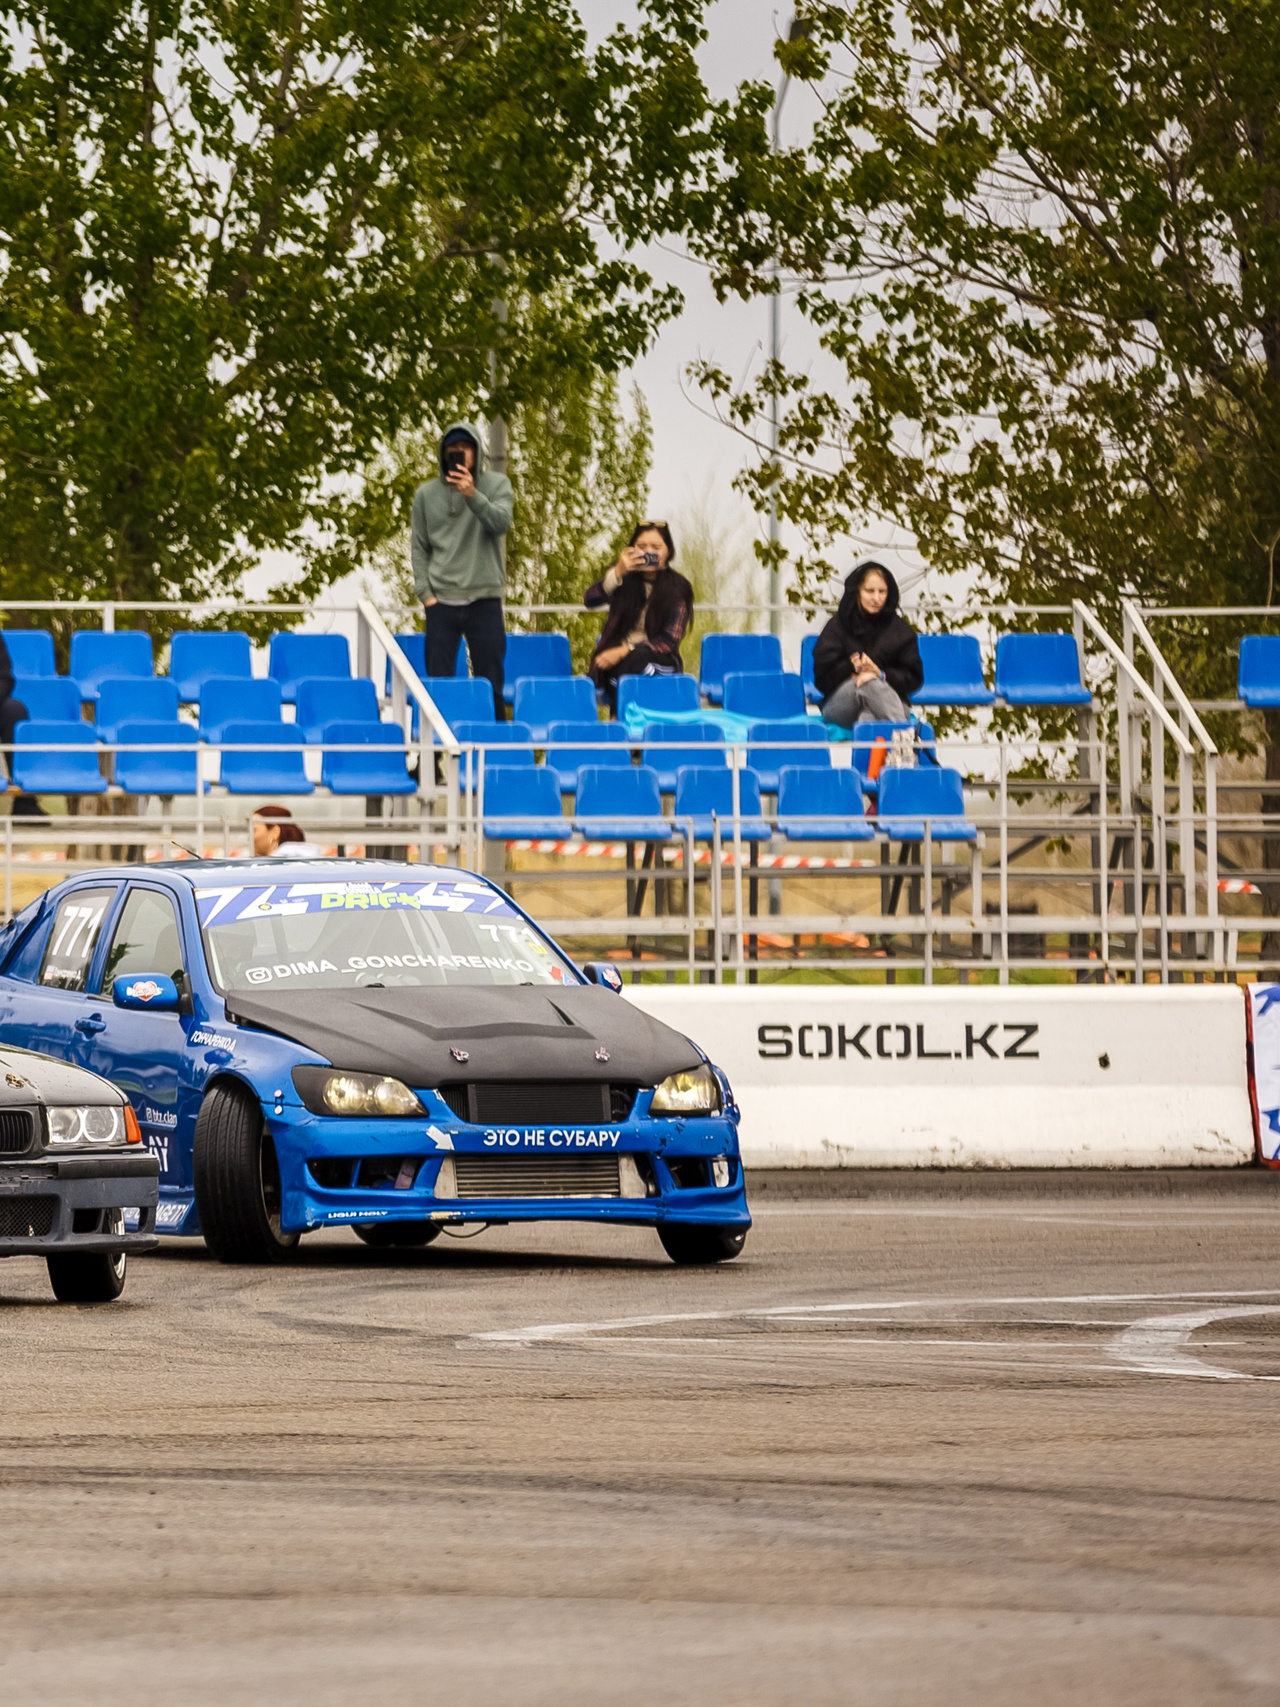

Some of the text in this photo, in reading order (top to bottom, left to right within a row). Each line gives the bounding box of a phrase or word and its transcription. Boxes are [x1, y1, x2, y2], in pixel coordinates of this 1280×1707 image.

[52, 905, 105, 958] 771
[478, 924, 541, 946] 771
[757, 1023, 1040, 1060] SOKOL.KZ
[483, 1129, 621, 1147] ЭТО НЕ СУБАРУ
[328, 1211, 357, 1219] LIQUI
